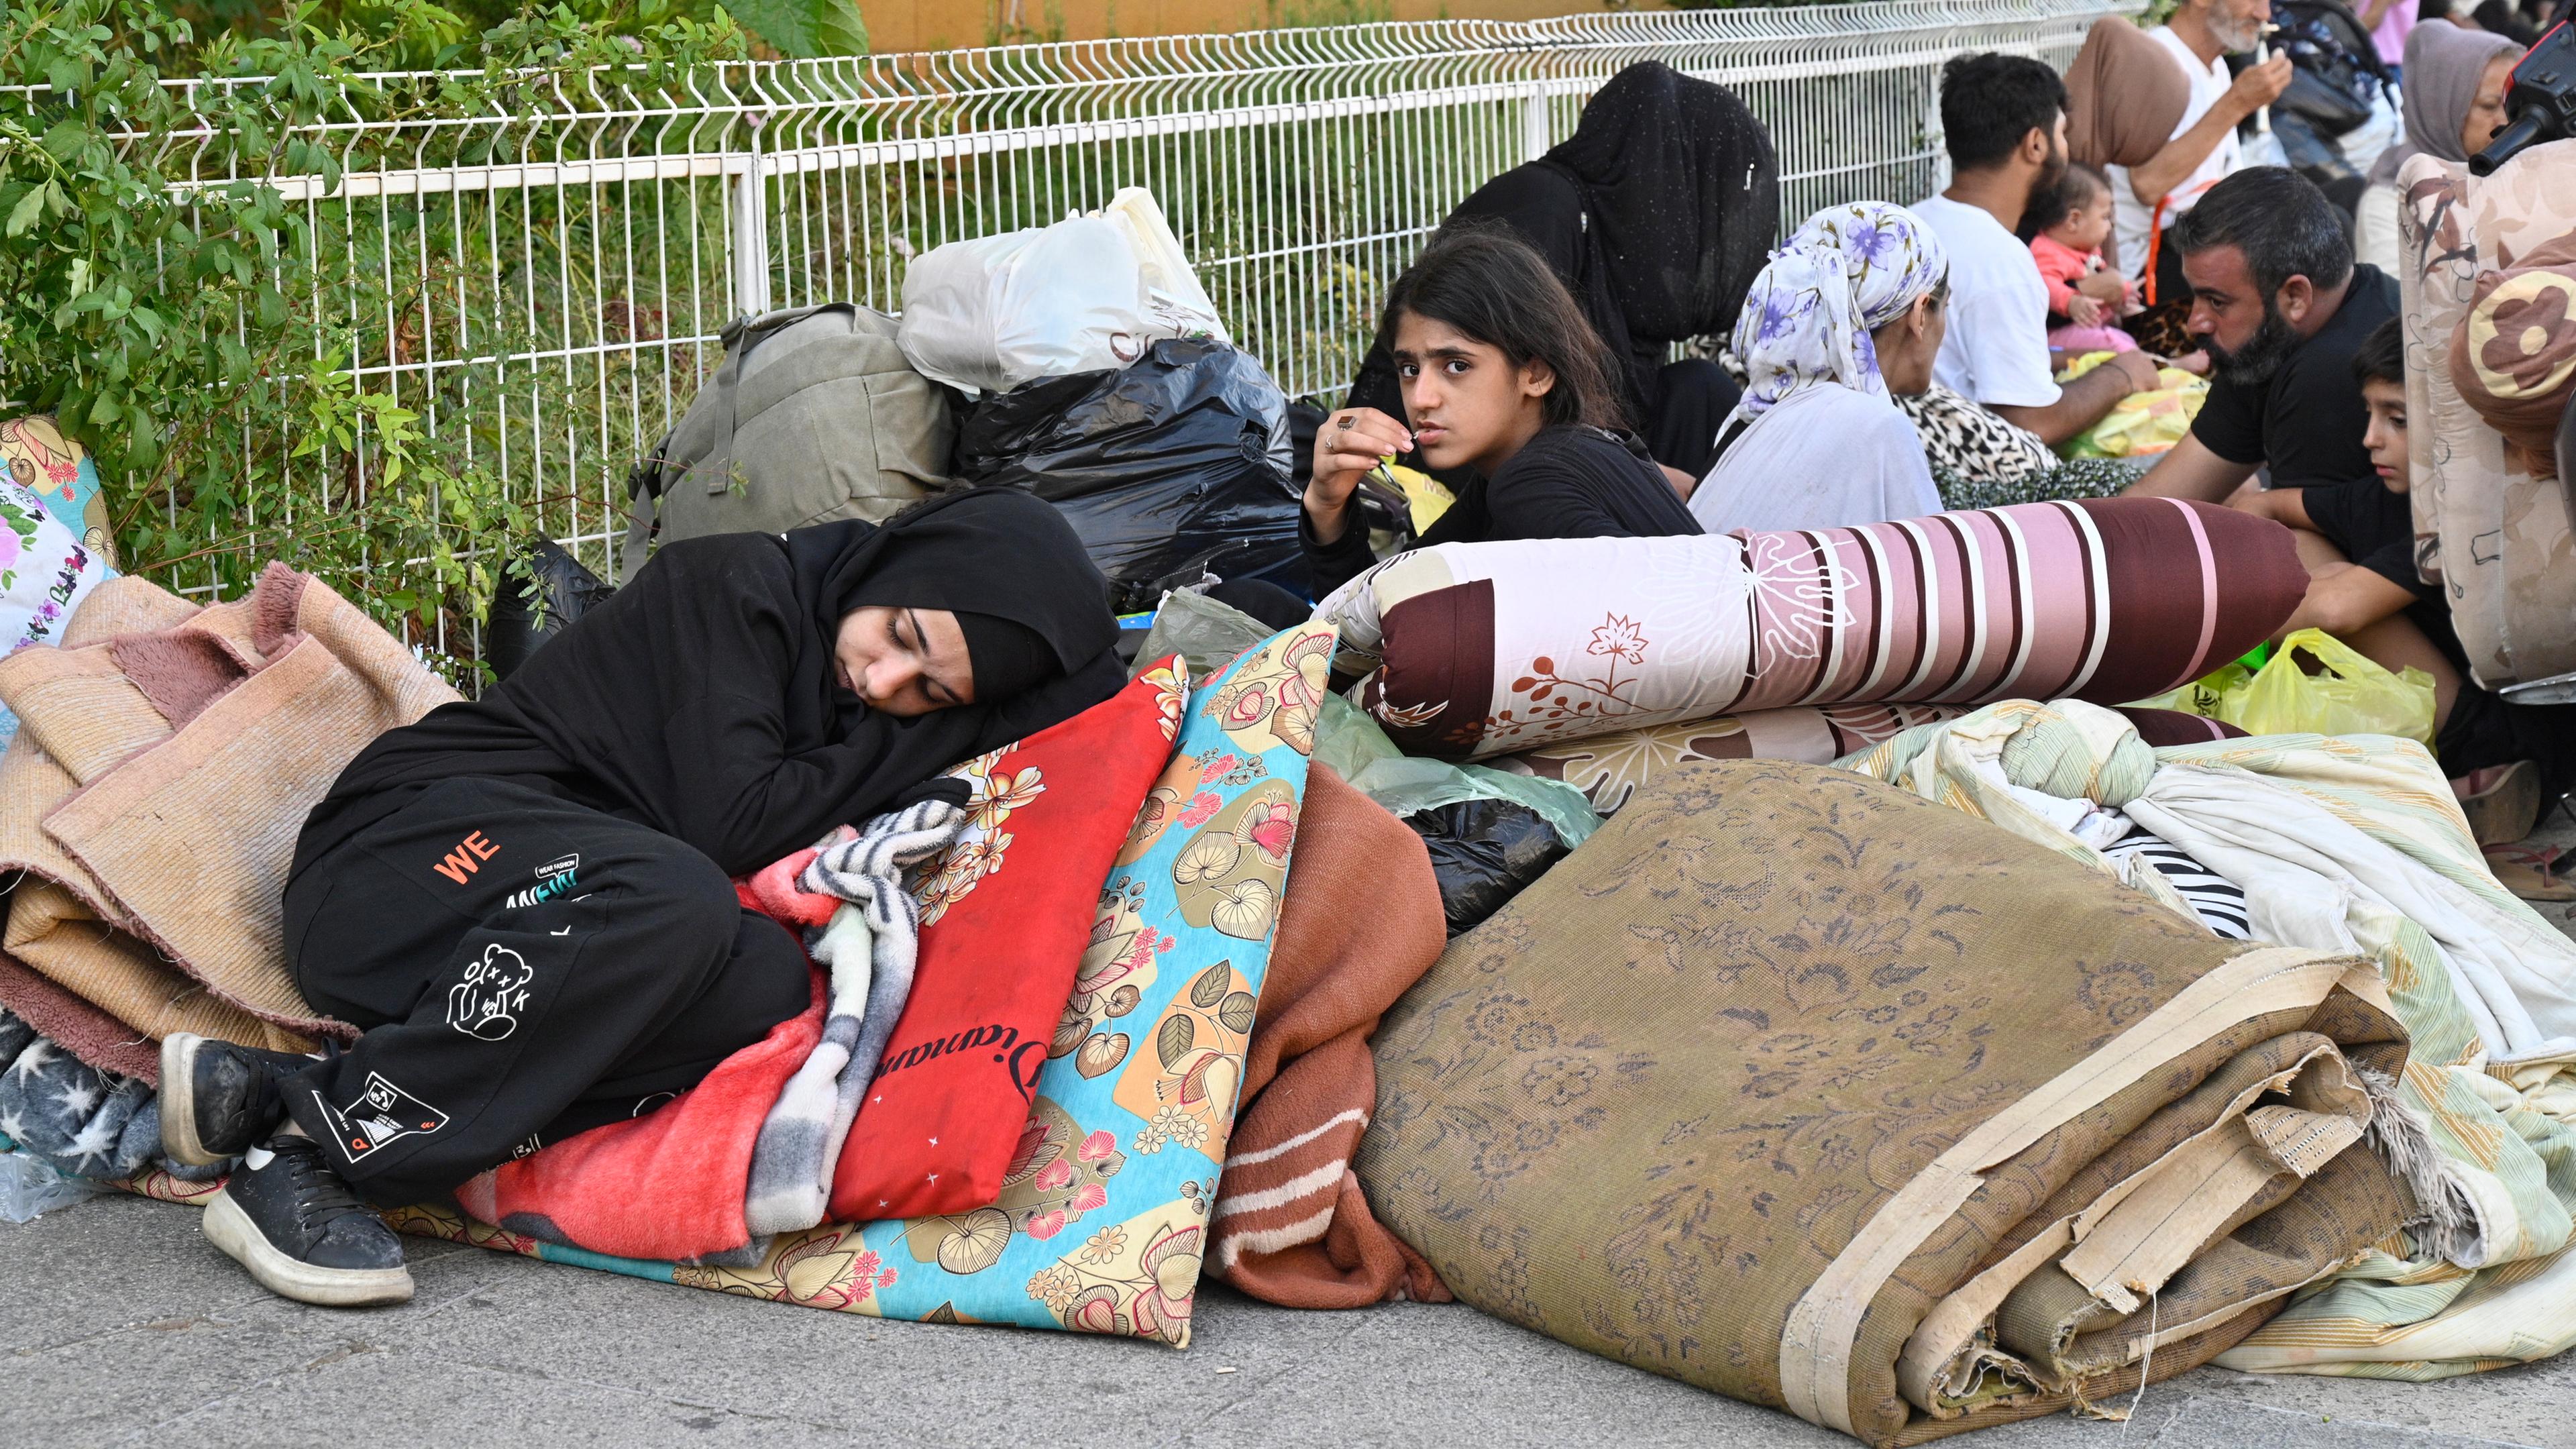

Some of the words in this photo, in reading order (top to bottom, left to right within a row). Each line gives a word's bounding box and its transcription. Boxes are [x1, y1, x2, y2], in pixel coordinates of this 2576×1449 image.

[433, 830, 501, 885] WE
[538, 865, 553, 874] WEAR
[553, 860, 575, 869] FASHION
[370, 1091, 382, 1103] NEW
